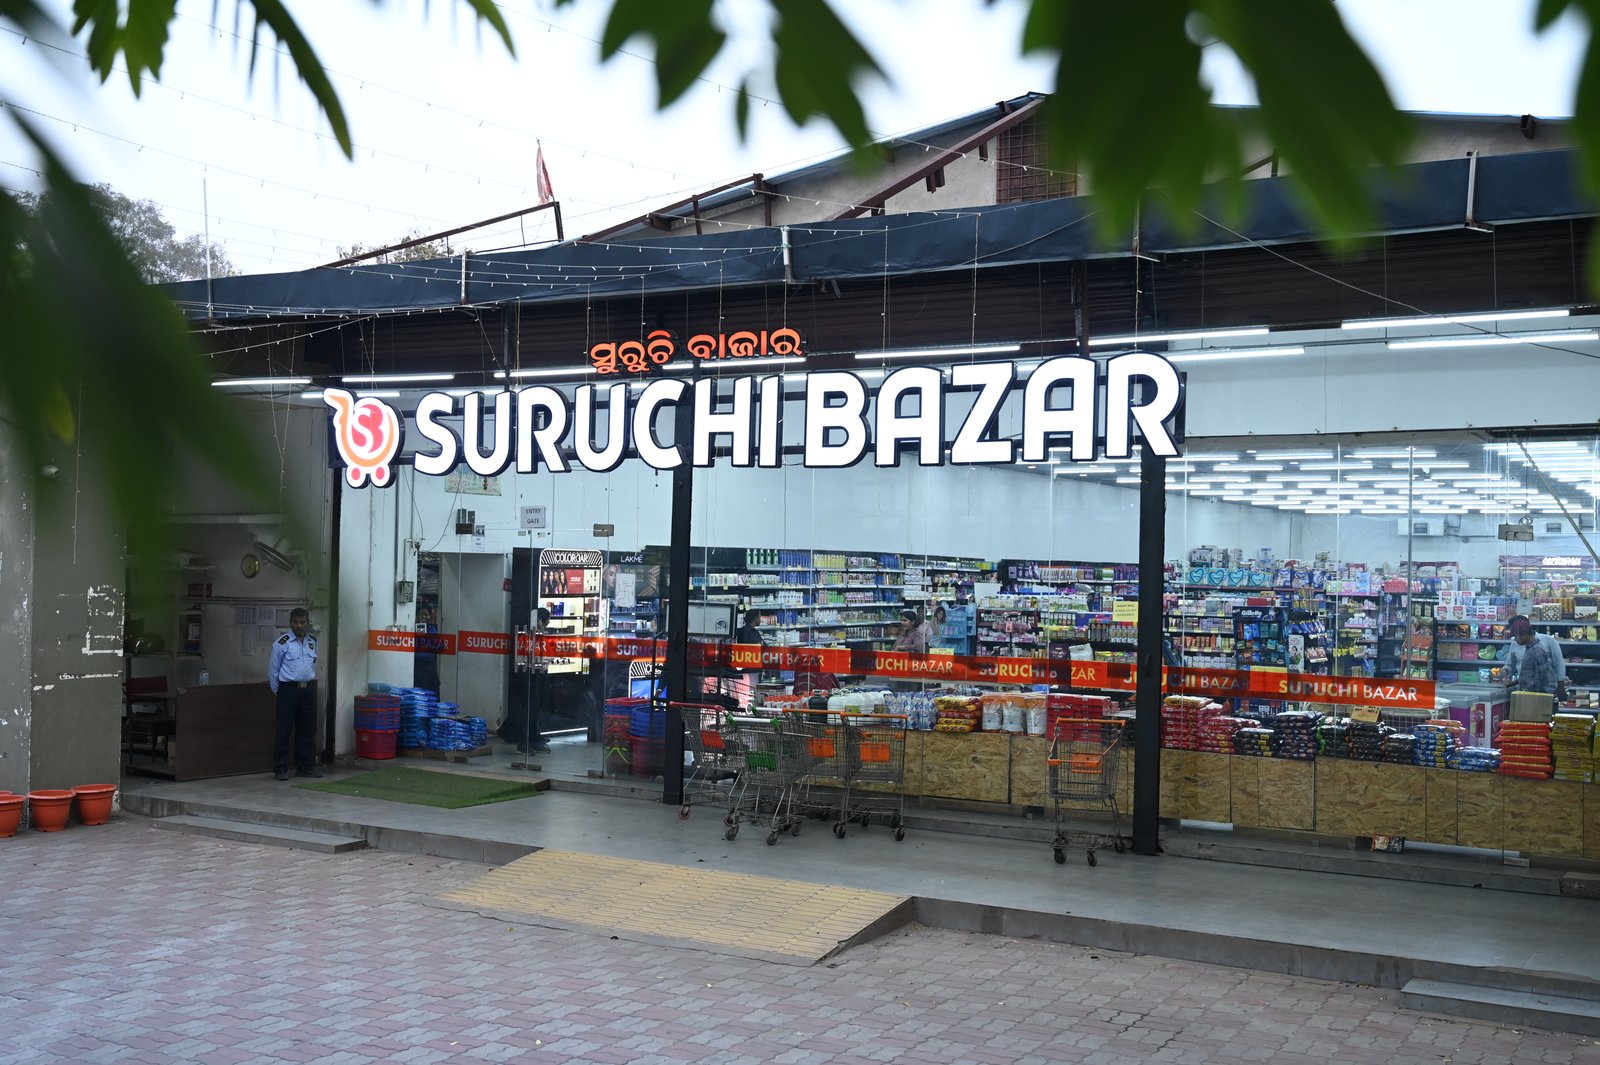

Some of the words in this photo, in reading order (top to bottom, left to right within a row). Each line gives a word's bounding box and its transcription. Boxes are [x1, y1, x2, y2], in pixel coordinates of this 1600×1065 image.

[687, 328, 804, 359] ବାଜାର
[413, 375, 783, 476] SURUCHI
[804, 352, 1182, 468] BAZAR
[466, 636, 511, 650] SURUCHI
[731, 650, 783, 665] SURUCHI
[911, 659, 953, 674] BAZAR
[978, 662, 1045, 679] SURUCHI
[1200, 674, 1250, 690] BAZAR
[1278, 679, 1358, 698] SURUCHI
[1363, 683, 1418, 701] BAZAR
